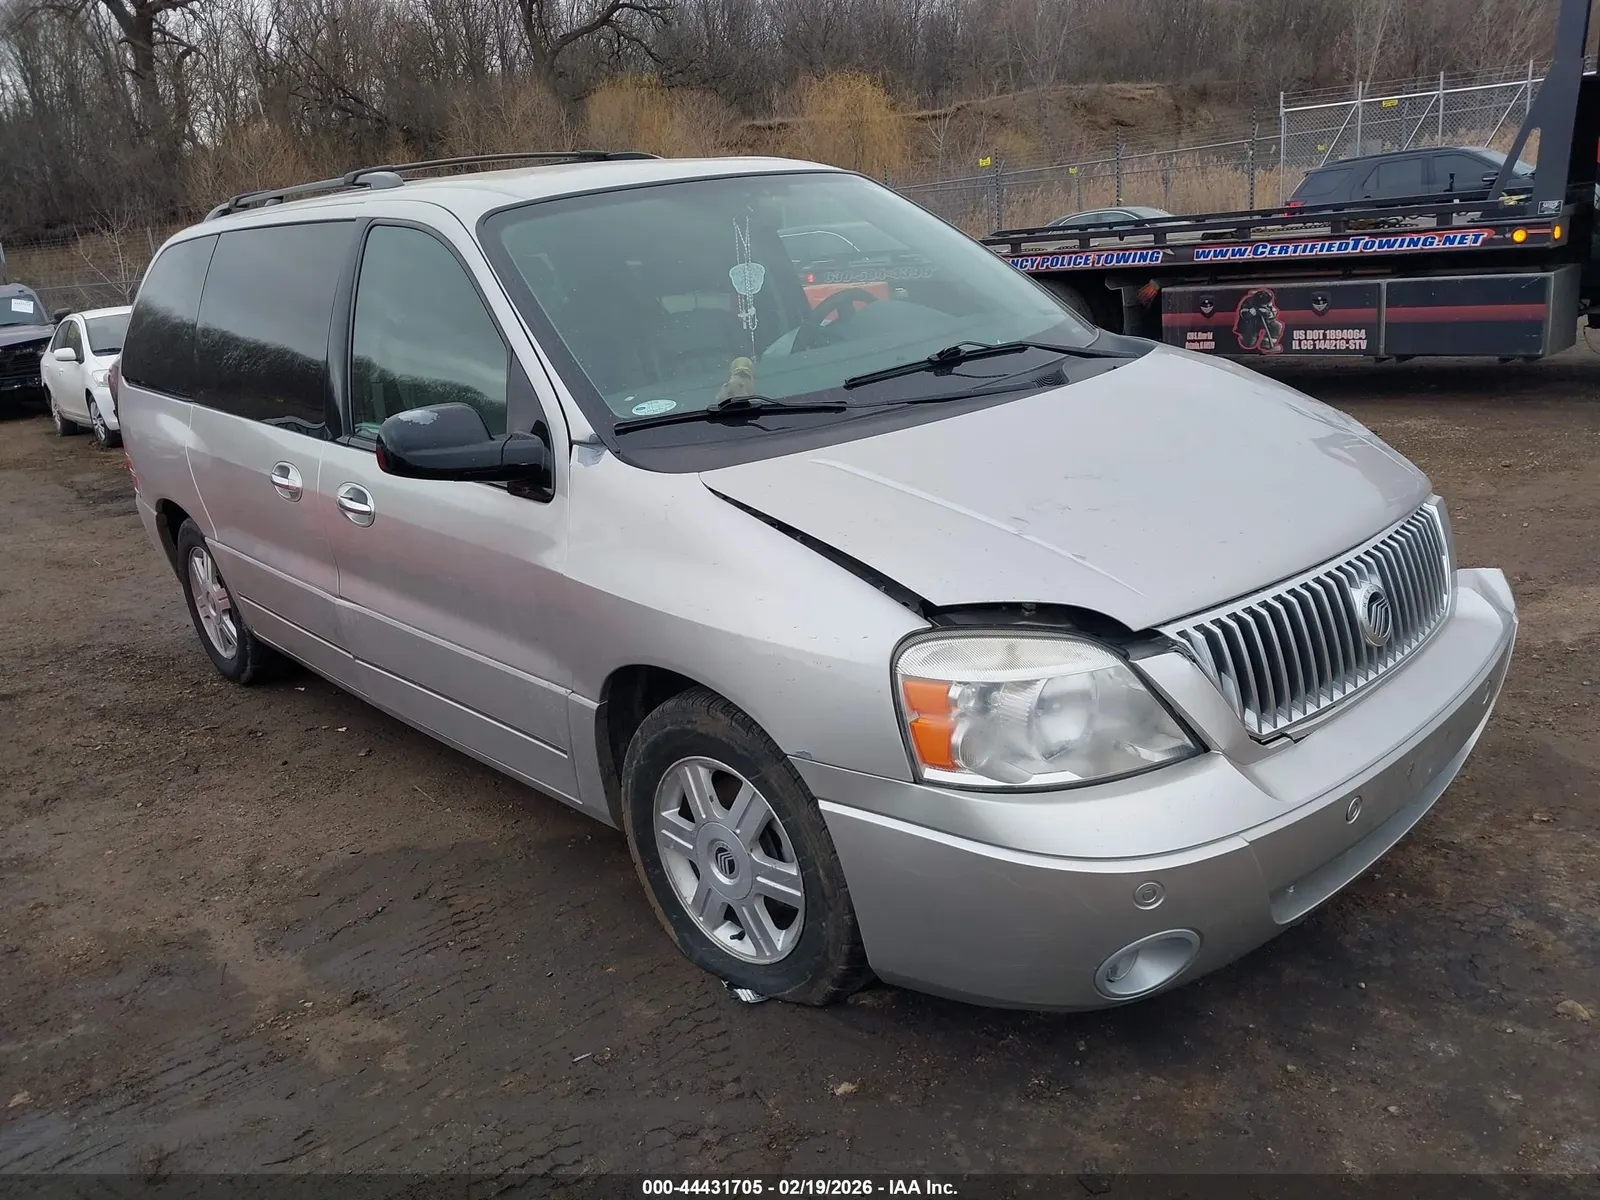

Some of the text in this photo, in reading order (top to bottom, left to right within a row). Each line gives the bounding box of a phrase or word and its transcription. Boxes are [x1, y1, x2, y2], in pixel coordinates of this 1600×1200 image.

[1006, 249, 1163, 271] NCY POLICE TOWING
[1293, 329, 1306, 340] US
[1306, 329, 1325, 340] DOT
[1301, 339, 1314, 350] CC
